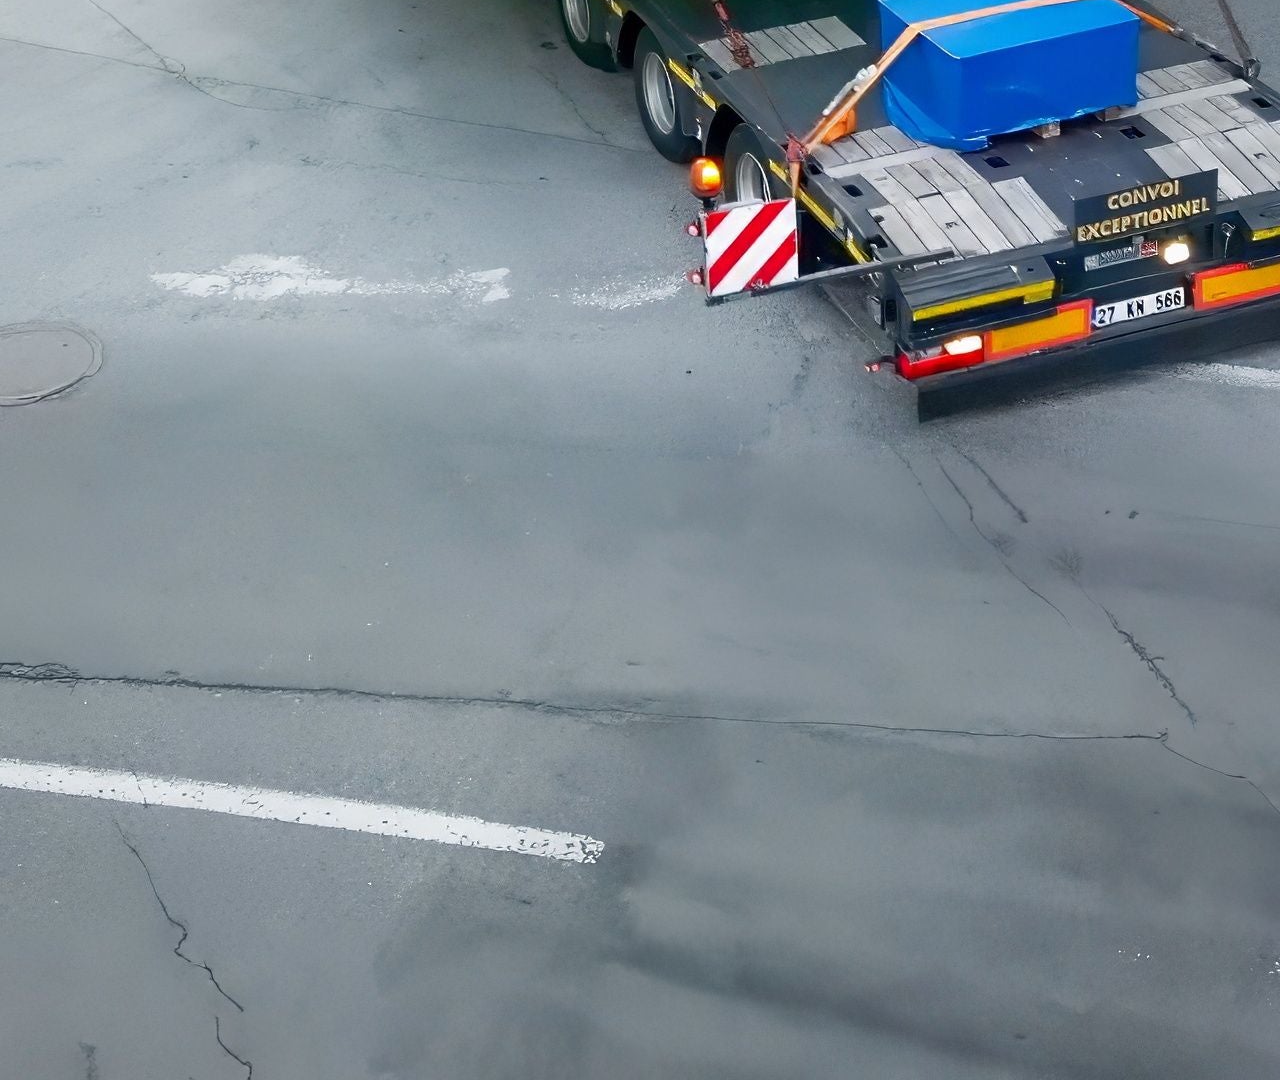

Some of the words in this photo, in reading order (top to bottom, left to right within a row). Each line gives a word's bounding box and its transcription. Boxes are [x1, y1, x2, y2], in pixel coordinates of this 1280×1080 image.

[1107, 179, 1180, 211] CONVOI
[1077, 197, 1211, 242] EXCEPTIONNEL
[1097, 305, 1116, 324] 27
[1126, 299, 1145, 319] KN
